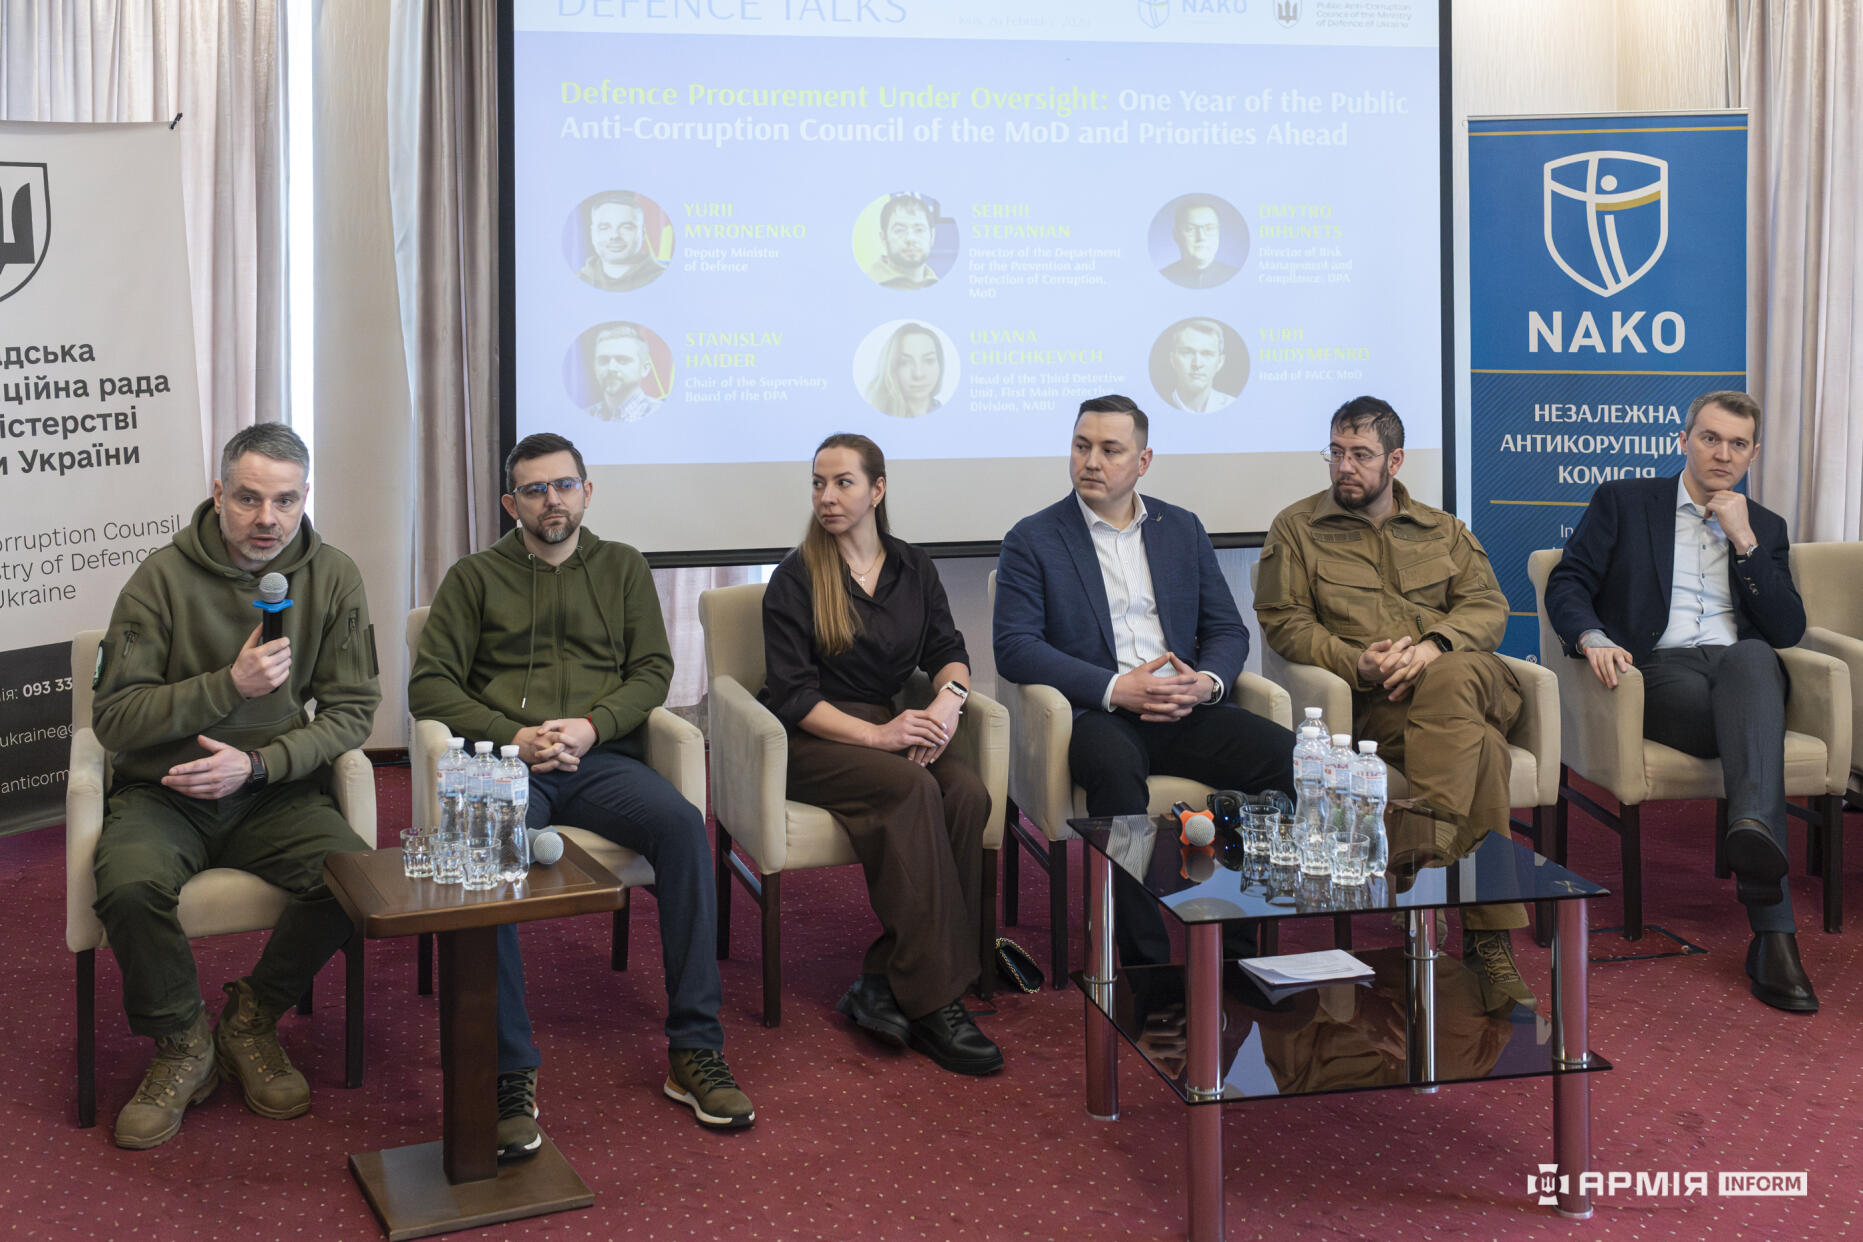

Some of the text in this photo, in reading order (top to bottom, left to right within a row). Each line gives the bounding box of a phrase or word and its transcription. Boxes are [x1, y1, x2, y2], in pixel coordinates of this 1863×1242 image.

[561, 78, 1408, 118] Defence Procurement Under Oversight: One Year of the Public
[560, 115, 1348, 148] Anti-Corruption Council of the MoD and Priorities Ahead
[683, 201, 734, 217] YURII
[971, 202, 1029, 217] SERHII
[1259, 203, 1333, 218] DMYTRO
[685, 223, 808, 239] MYRONENKO
[971, 223, 1072, 239] STEPANIAN
[684, 247, 780, 260] Deputy Minister
[969, 247, 1014, 258] Director
[1017, 246, 1031, 257] of
[1033, 247, 1051, 257] the
[683, 261, 749, 272] of Defence
[1074, 260, 1096, 271] and
[685, 330, 784, 347] STANISLAV
[970, 329, 1038, 345] ULYANA
[1259, 327, 1303, 341] YURII
[1528, 311, 1686, 354] NAKO
[0, 343, 95, 369] дська
[686, 352, 757, 368] HAIDER
[970, 348, 1104, 365] CHUCHKEVYCH
[1259, 346, 1370, 361] HUDYMENKO
[3, 374, 171, 405] ційна рада
[685, 376, 716, 388] Chair
[720, 376, 733, 387] of
[736, 376, 756, 387] the
[724, 390, 737, 401] of
[740, 390, 760, 401] the
[1534, 404, 1681, 424] НЕЗАЛЕЖНА
[18, 442, 140, 476] України
[1558, 465, 1656, 484] КОМІСІЯ
[0, 514, 181, 552] rruption Counsil
[0, 562, 33, 582] try
[41, 554, 64, 575] of
[0, 688, 18, 701] ія:
[22, 680, 51, 698] 093
